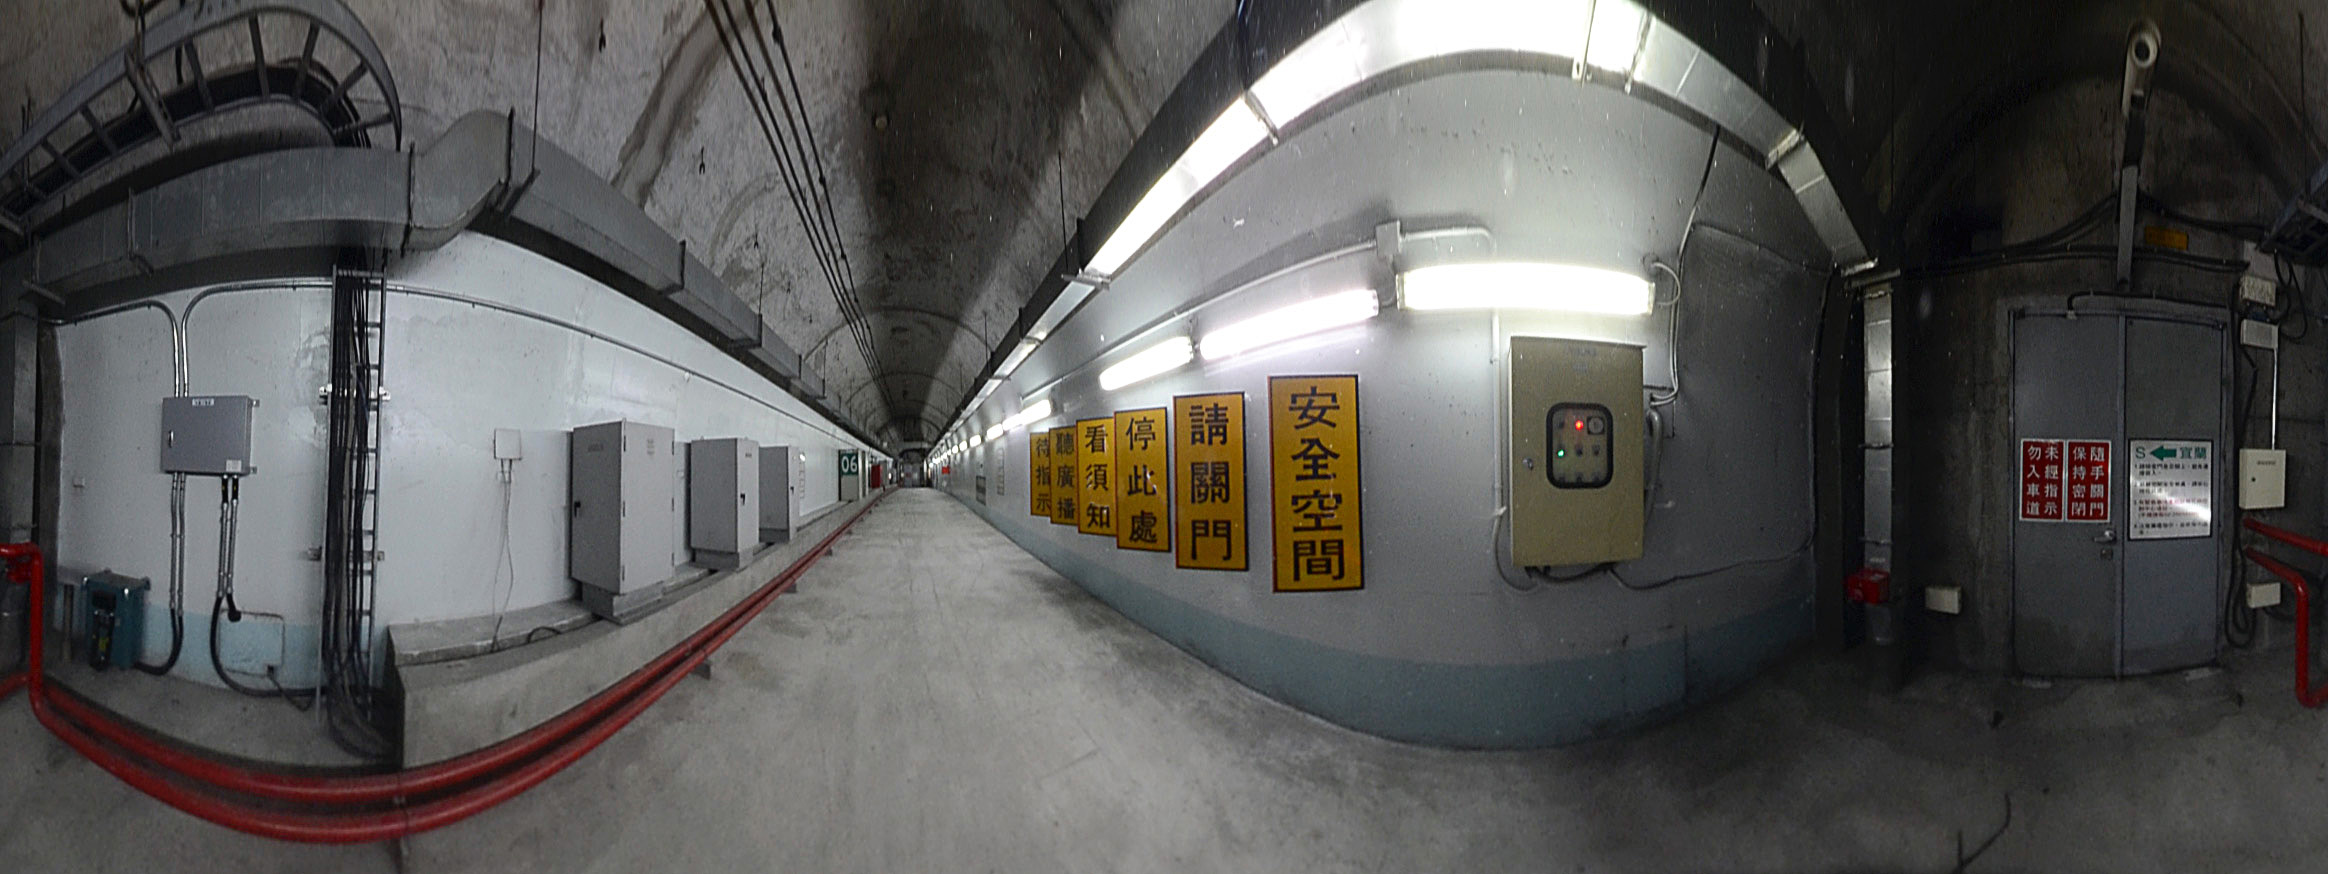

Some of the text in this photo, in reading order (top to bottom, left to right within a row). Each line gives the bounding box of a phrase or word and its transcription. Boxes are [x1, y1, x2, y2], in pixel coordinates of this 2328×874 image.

[841, 456, 858, 473] 06
[1035, 437, 1050, 513] 待指示
[1055, 430, 1075, 521] 聽廣播
[1085, 425, 1111, 529] 看須知
[1125, 416, 1157, 544] 停此處
[1189, 402, 1232, 561] 請關門
[1288, 386, 1345, 582] 安全空間
[2026, 446, 2042, 516] 勿入車道
[2044, 446, 2059, 516] 未經指示
[2071, 446, 2087, 517] 保持密閉
[2089, 446, 2105, 517] 隨手關門
[2135, 446, 2146, 459] S
[2179, 446, 2207, 459] 宜蘭
